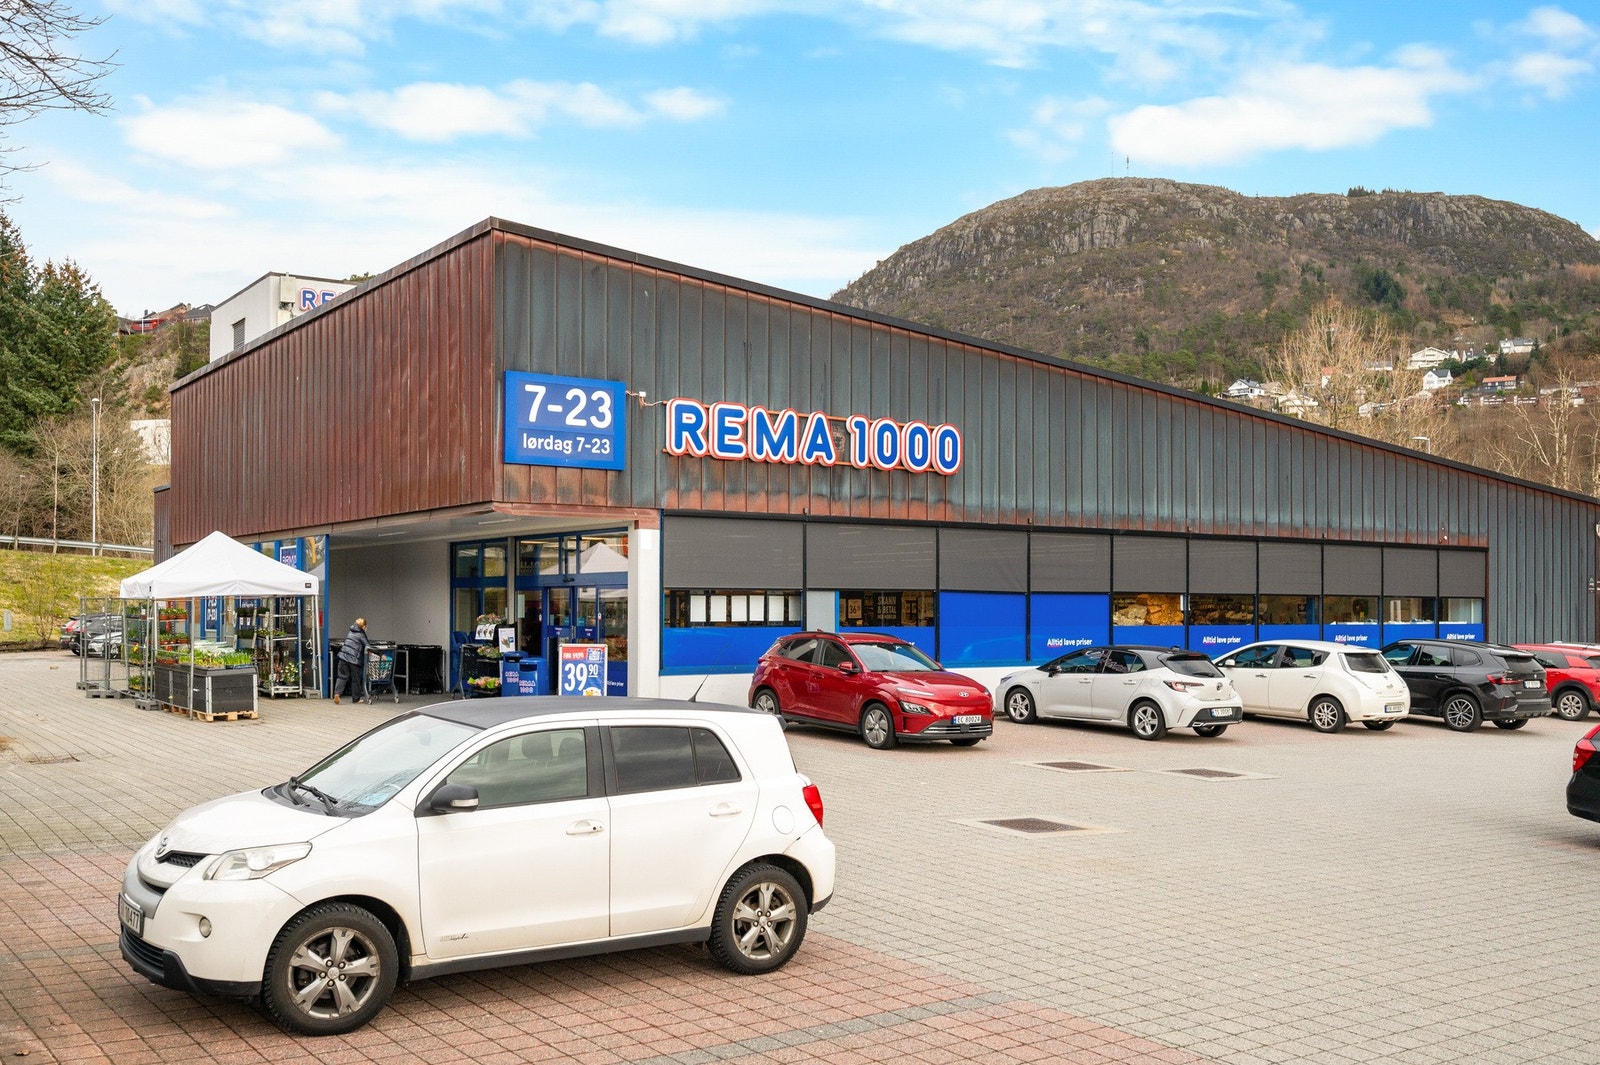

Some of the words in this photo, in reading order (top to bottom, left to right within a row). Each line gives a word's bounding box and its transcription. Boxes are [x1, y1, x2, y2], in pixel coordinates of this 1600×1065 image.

[300, 289, 340, 310] RE
[525, 384, 612, 428] 7-23
[523, 432, 572, 454] lørdag
[576, 437, 610, 454] 7-23
[666, 397, 836, 467] REMA
[846, 414, 962, 476] 1000
[878, 596, 896, 605] SKANN
[1047, 638, 1063, 647] Alltid
[1064, 638, 1075, 646] lave
[1076, 638, 1092, 647] priser
[1202, 636, 1216, 644] Alltid
[1227, 636, 1241, 645] priser
[564, 662, 588, 692] 39
[588, 663, 599, 676] 90
